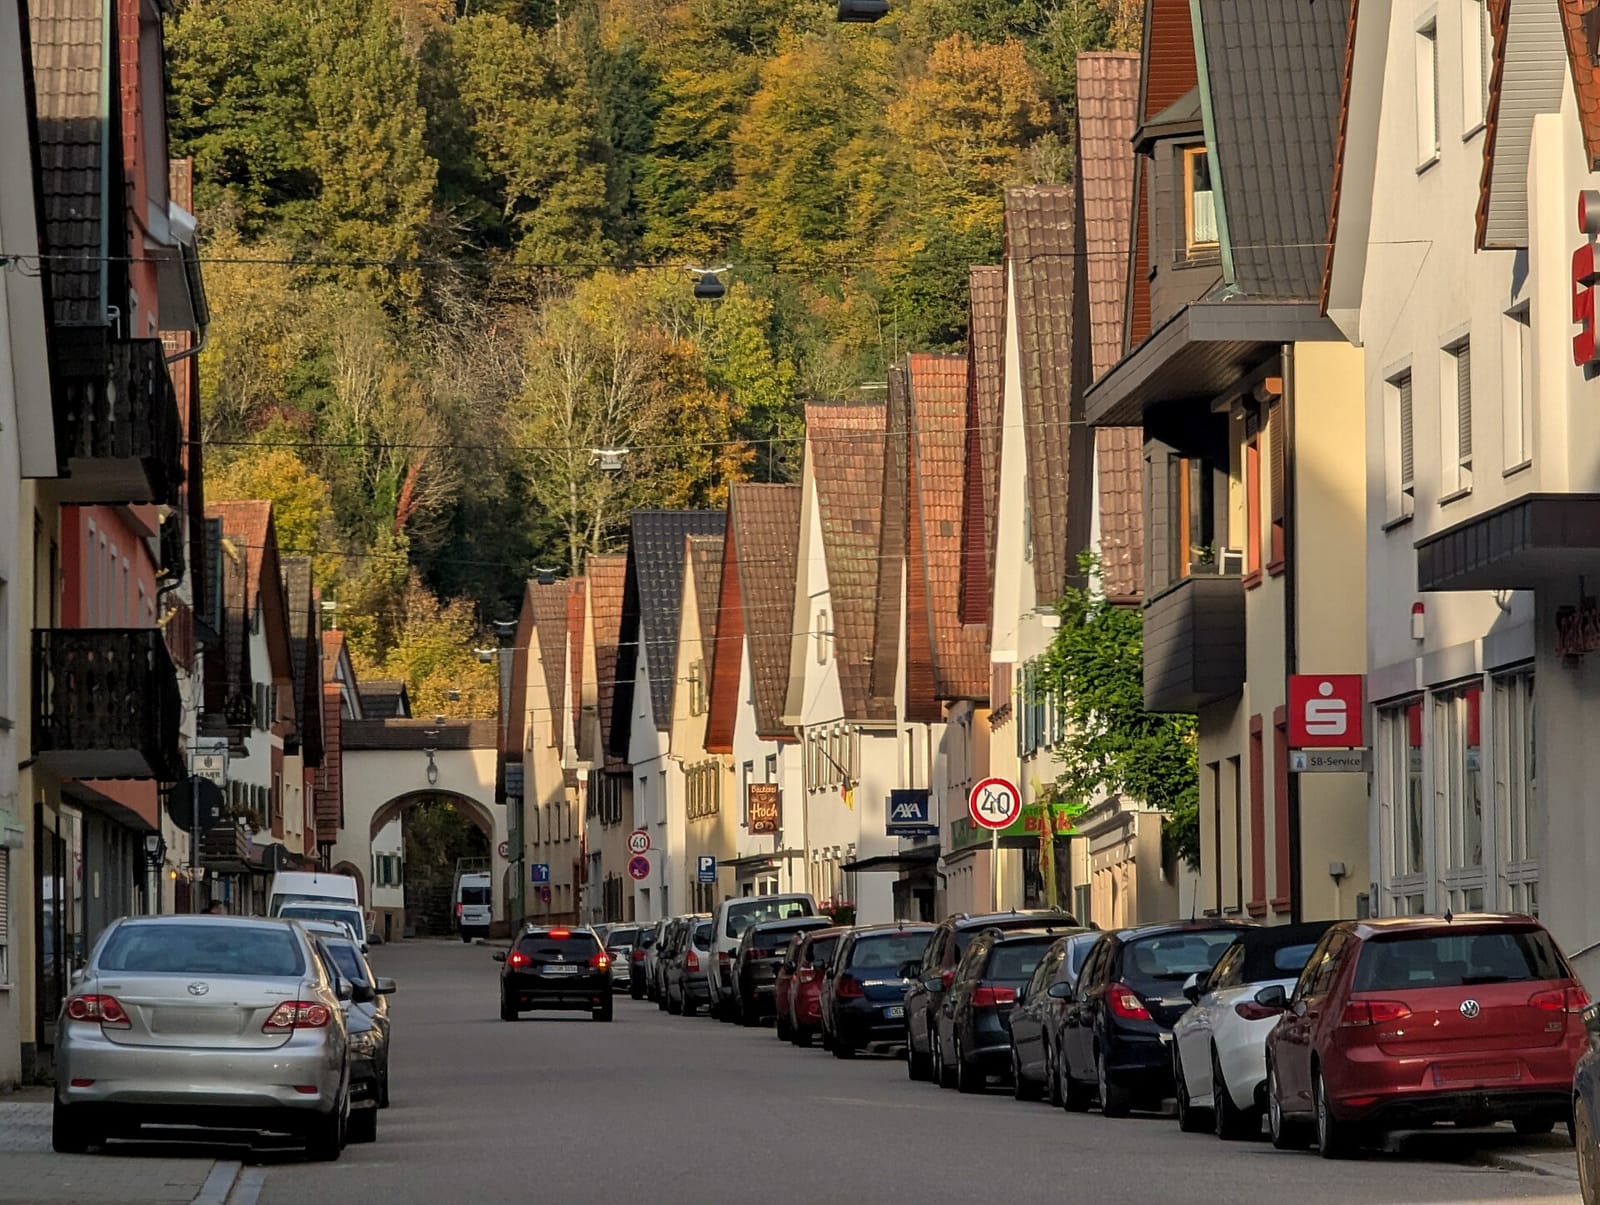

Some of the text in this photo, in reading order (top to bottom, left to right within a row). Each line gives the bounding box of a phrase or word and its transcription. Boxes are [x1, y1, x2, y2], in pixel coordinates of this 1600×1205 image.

[1311, 757, 1361, 767] SB-Service
[981, 789, 1011, 815] 40
[750, 803, 778, 820] Hoch
[891, 803, 922, 818] AXA
[632, 837, 646, 849] 40
[701, 858, 713, 871] P
